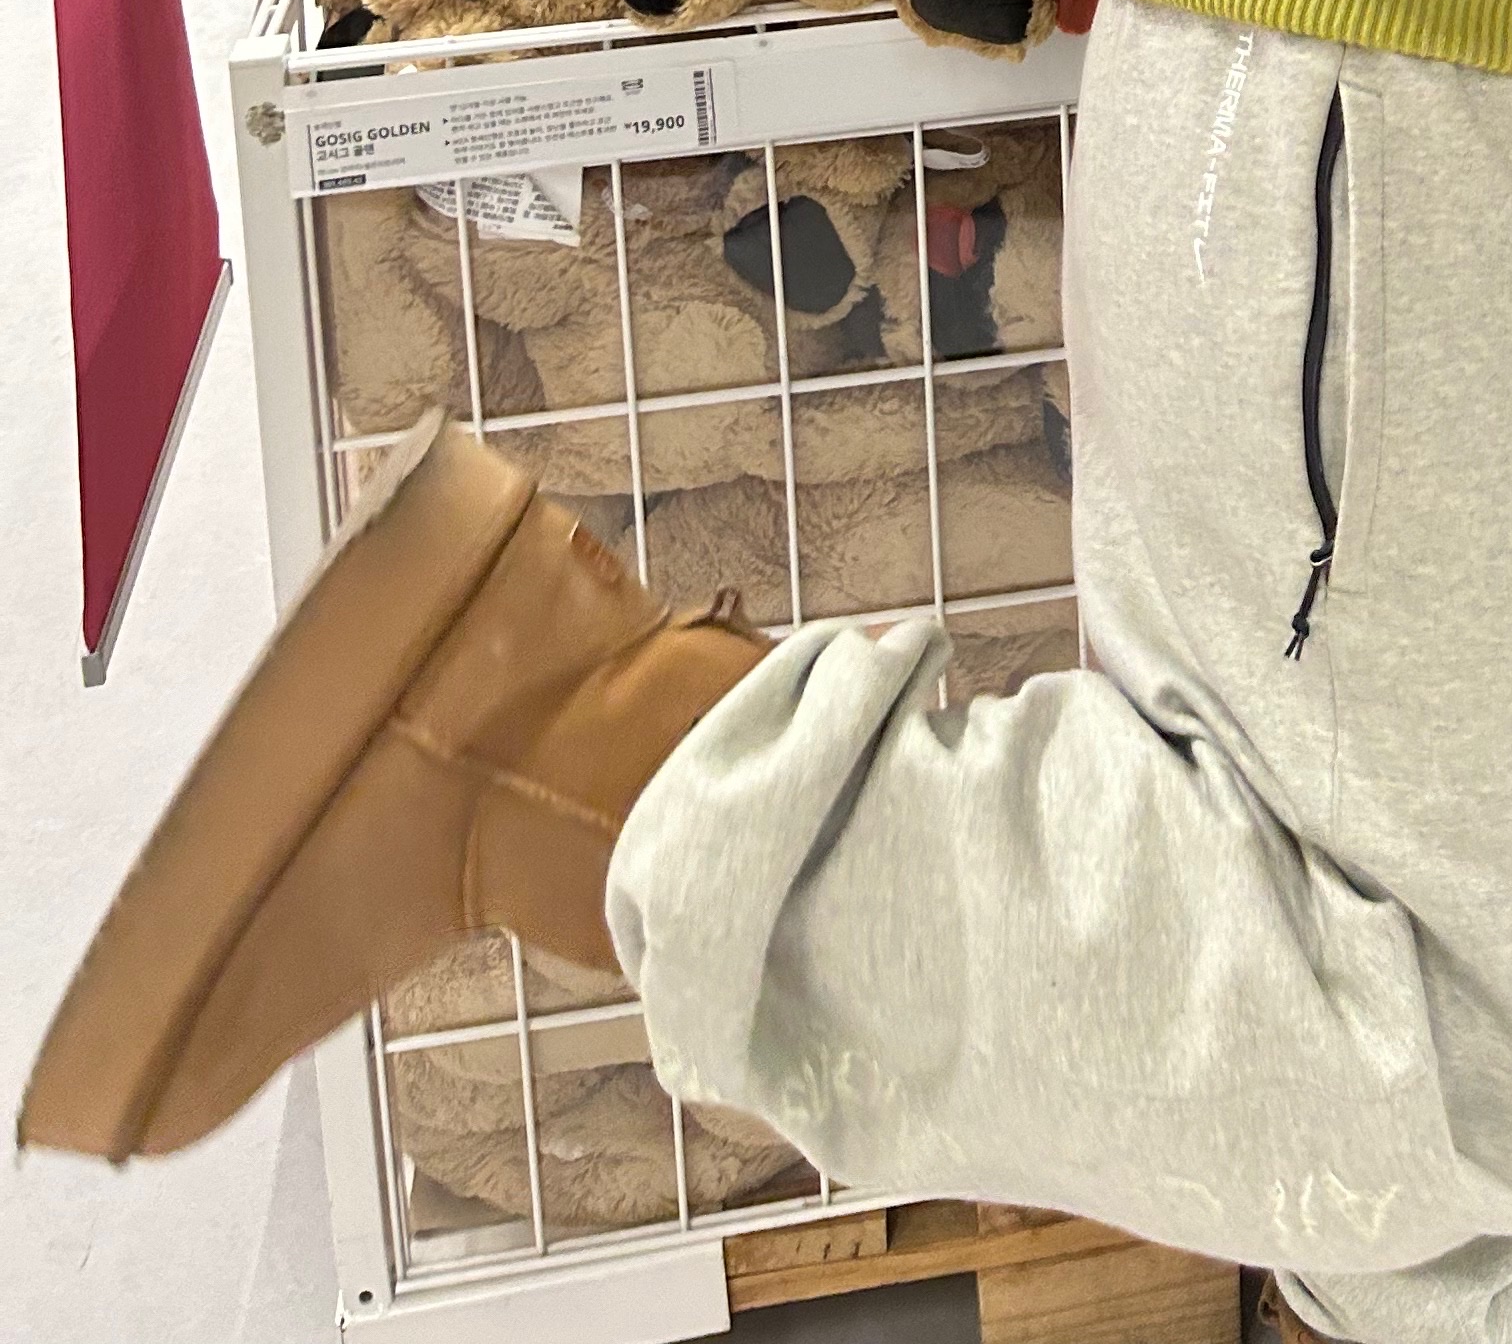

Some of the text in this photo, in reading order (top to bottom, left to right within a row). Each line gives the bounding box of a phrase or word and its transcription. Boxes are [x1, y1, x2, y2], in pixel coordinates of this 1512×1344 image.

[315, 120, 431, 148] GOSIG GOLDEN
[1193, 31, 1254, 238] THERMA-FIT
[316, 146, 350, 162] 고시그
